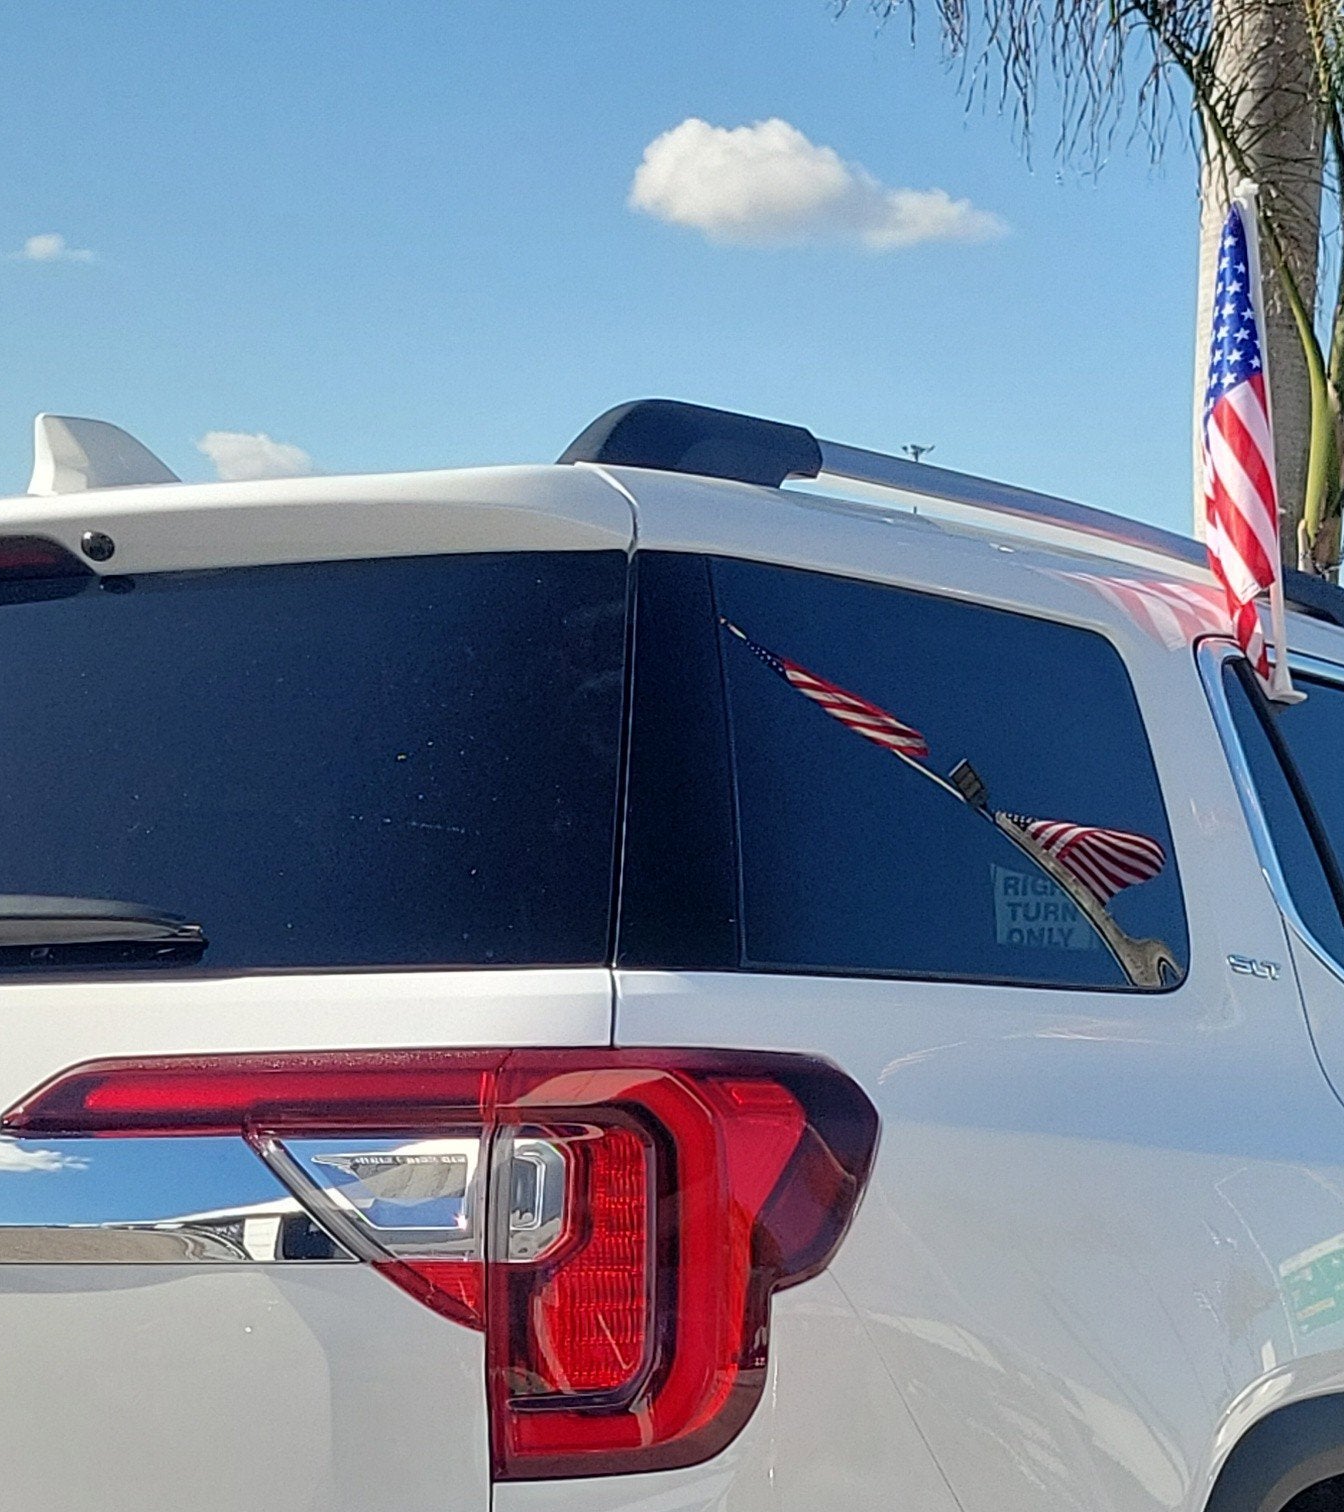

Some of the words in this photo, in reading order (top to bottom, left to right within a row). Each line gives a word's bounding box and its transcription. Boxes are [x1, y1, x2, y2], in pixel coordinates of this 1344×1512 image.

[1003, 876, 1065, 896] RIG
[1007, 901, 1077, 922] TURN
[1007, 926, 1074, 947] ONLY
[1225, 953, 1280, 982] SLT
